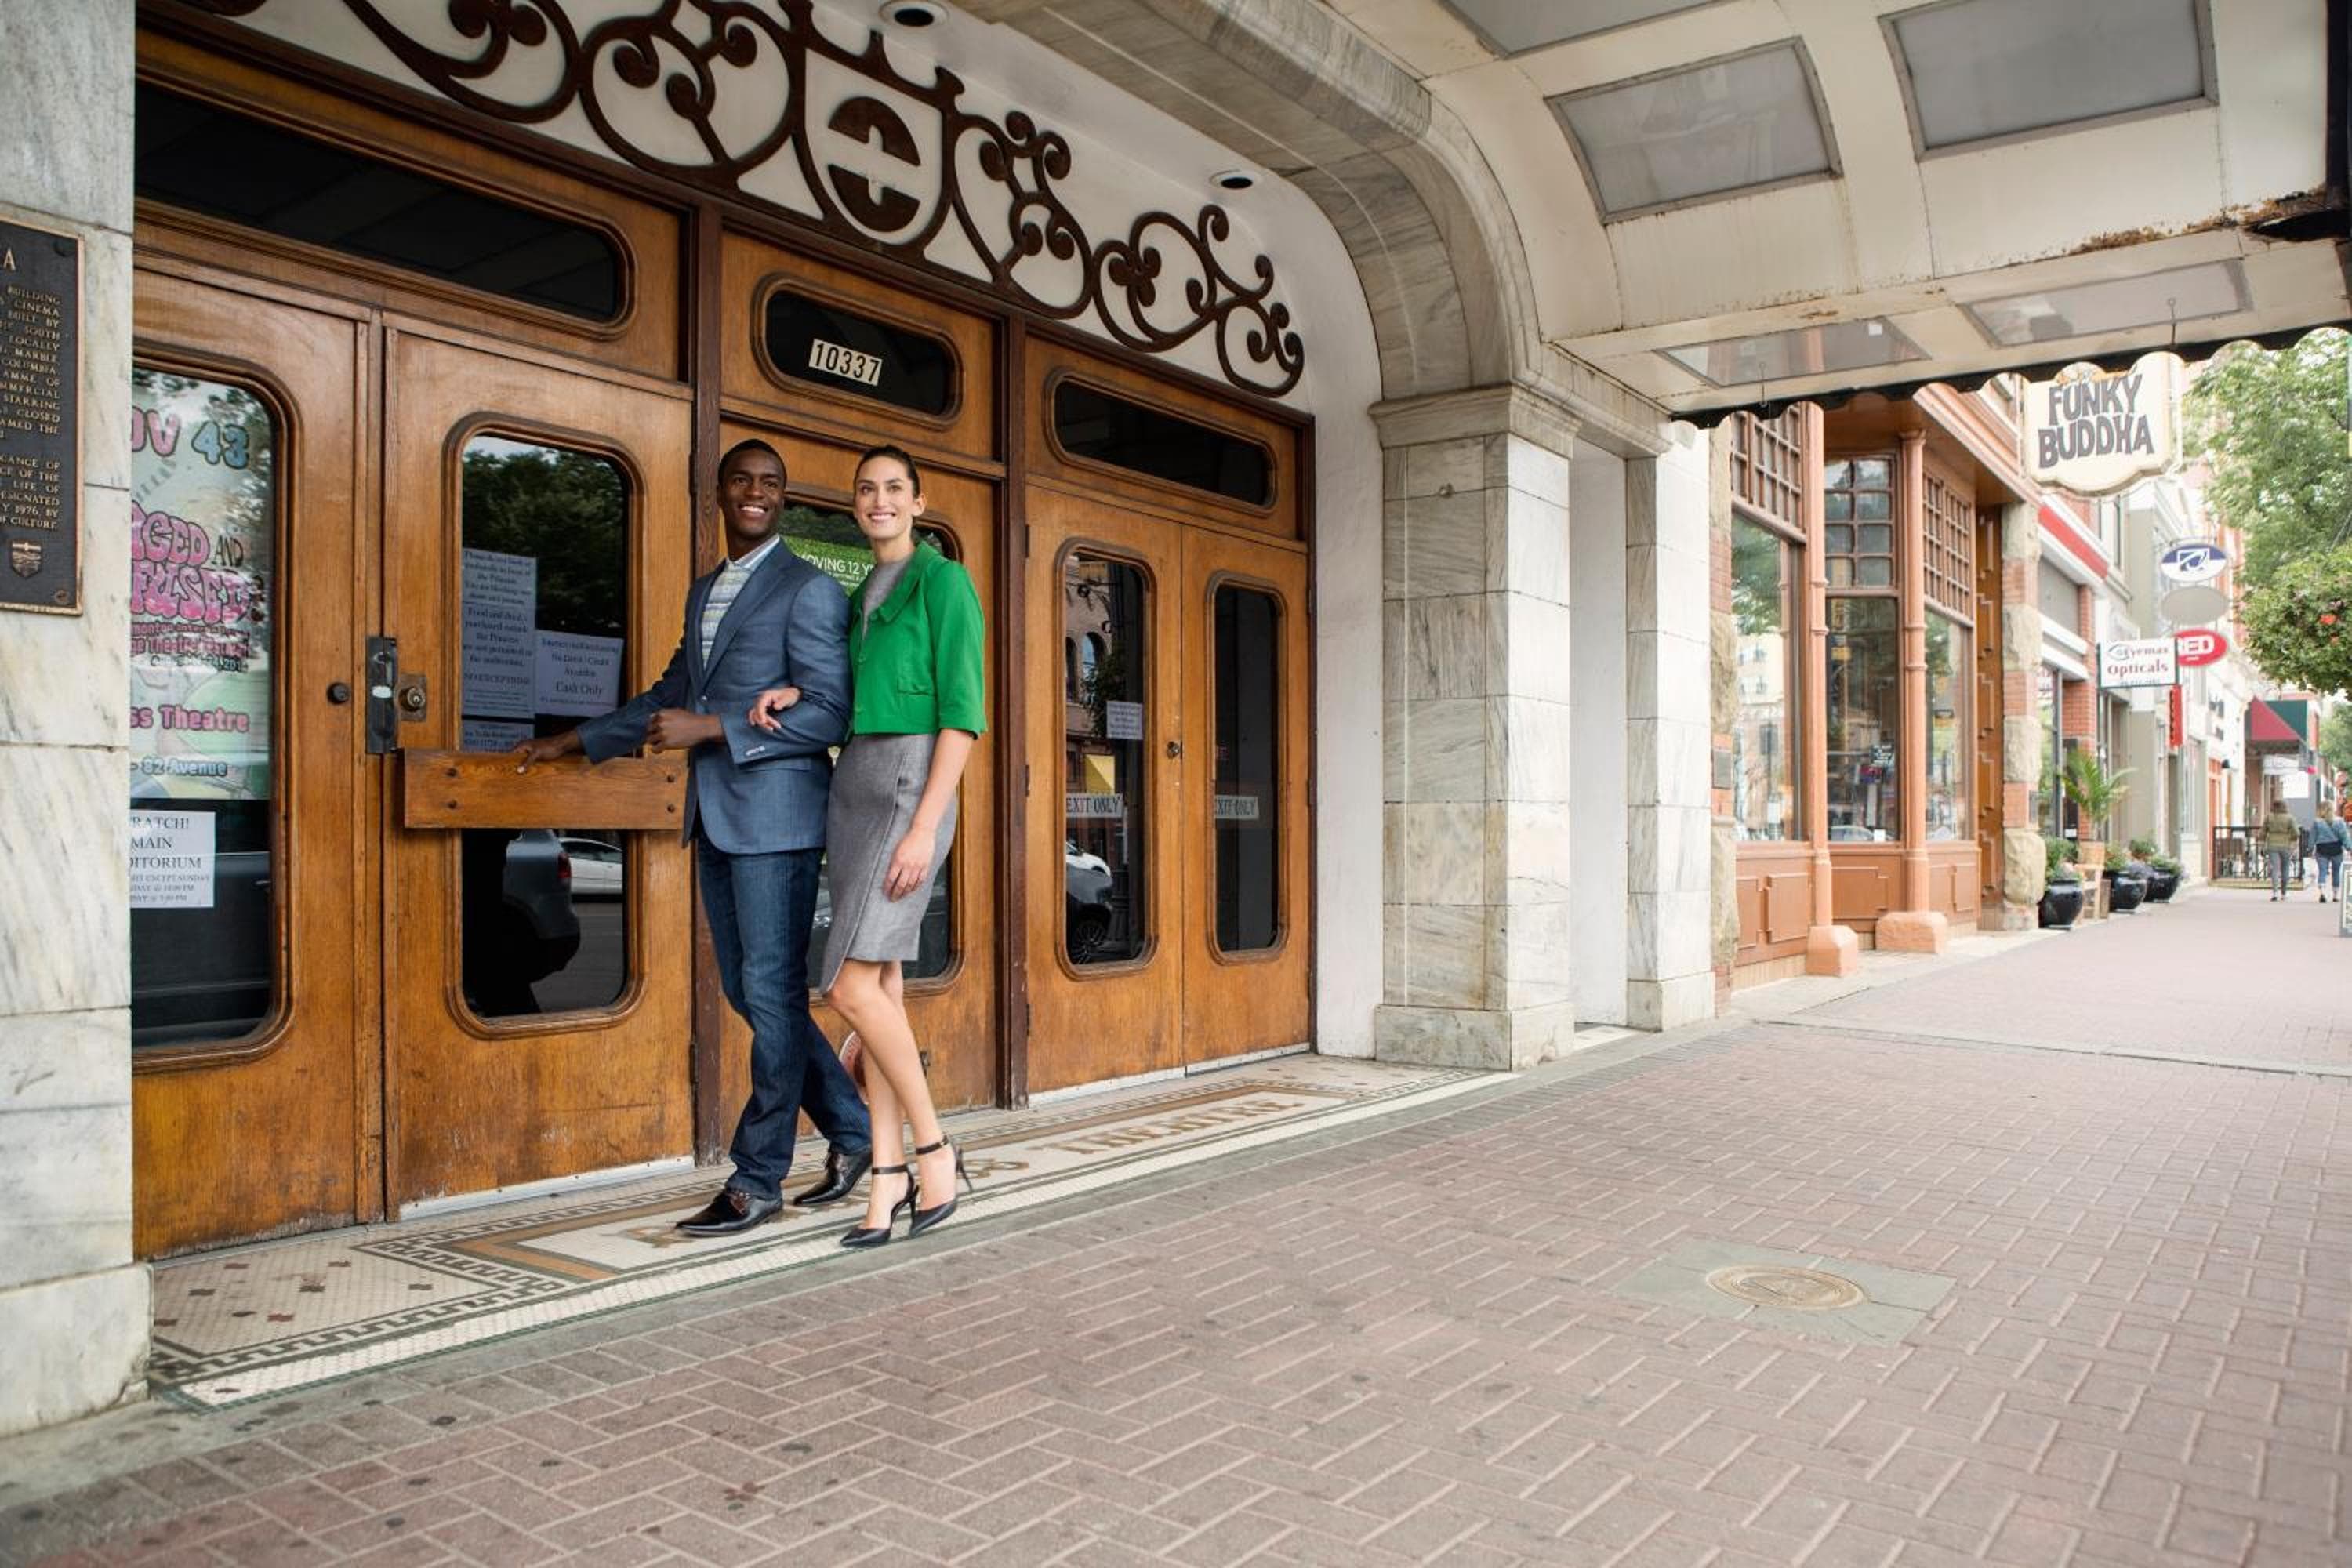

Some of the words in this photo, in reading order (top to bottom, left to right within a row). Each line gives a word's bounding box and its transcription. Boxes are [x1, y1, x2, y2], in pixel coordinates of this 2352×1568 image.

[3, 248, 16, 270] A
[7, 285, 60, 305] BUILDING
[14, 299, 60, 317] CINEMA
[46, 317, 60, 328] BY
[24, 325, 60, 340] SOUTH
[9, 335, 60, 351] LOCALLY
[812, 342, 880, 384] 10337
[46, 377, 60, 387] OF
[3, 393, 60, 410] STARRING
[2049, 374, 2143, 426] FUNKY
[16, 408, 60, 423] CLOSED
[40, 424, 60, 434] THE
[191, 421, 250, 470] 43
[2038, 414, 2154, 469] BUDDHA
[46, 460, 60, 470] OF
[19, 470, 33, 479] OF
[39, 471, 60, 481] THE
[13, 479, 37, 491] LIFE
[45, 485, 60, 494] OF
[46, 508, 59, 518] BY
[212, 535, 244, 567] AND
[848, 561, 861, 575] 12
[2107, 659, 2169, 677] Opticals
[158, 704, 250, 733] Theatre
[140, 757, 165, 775] 82
[165, 758, 229, 777] Avenue
[1066, 797, 1091, 814] EXIT
[1093, 796, 1120, 814] ONLY
[1214, 798, 1232, 815] XIT
[132, 837, 173, 849] MAIN
